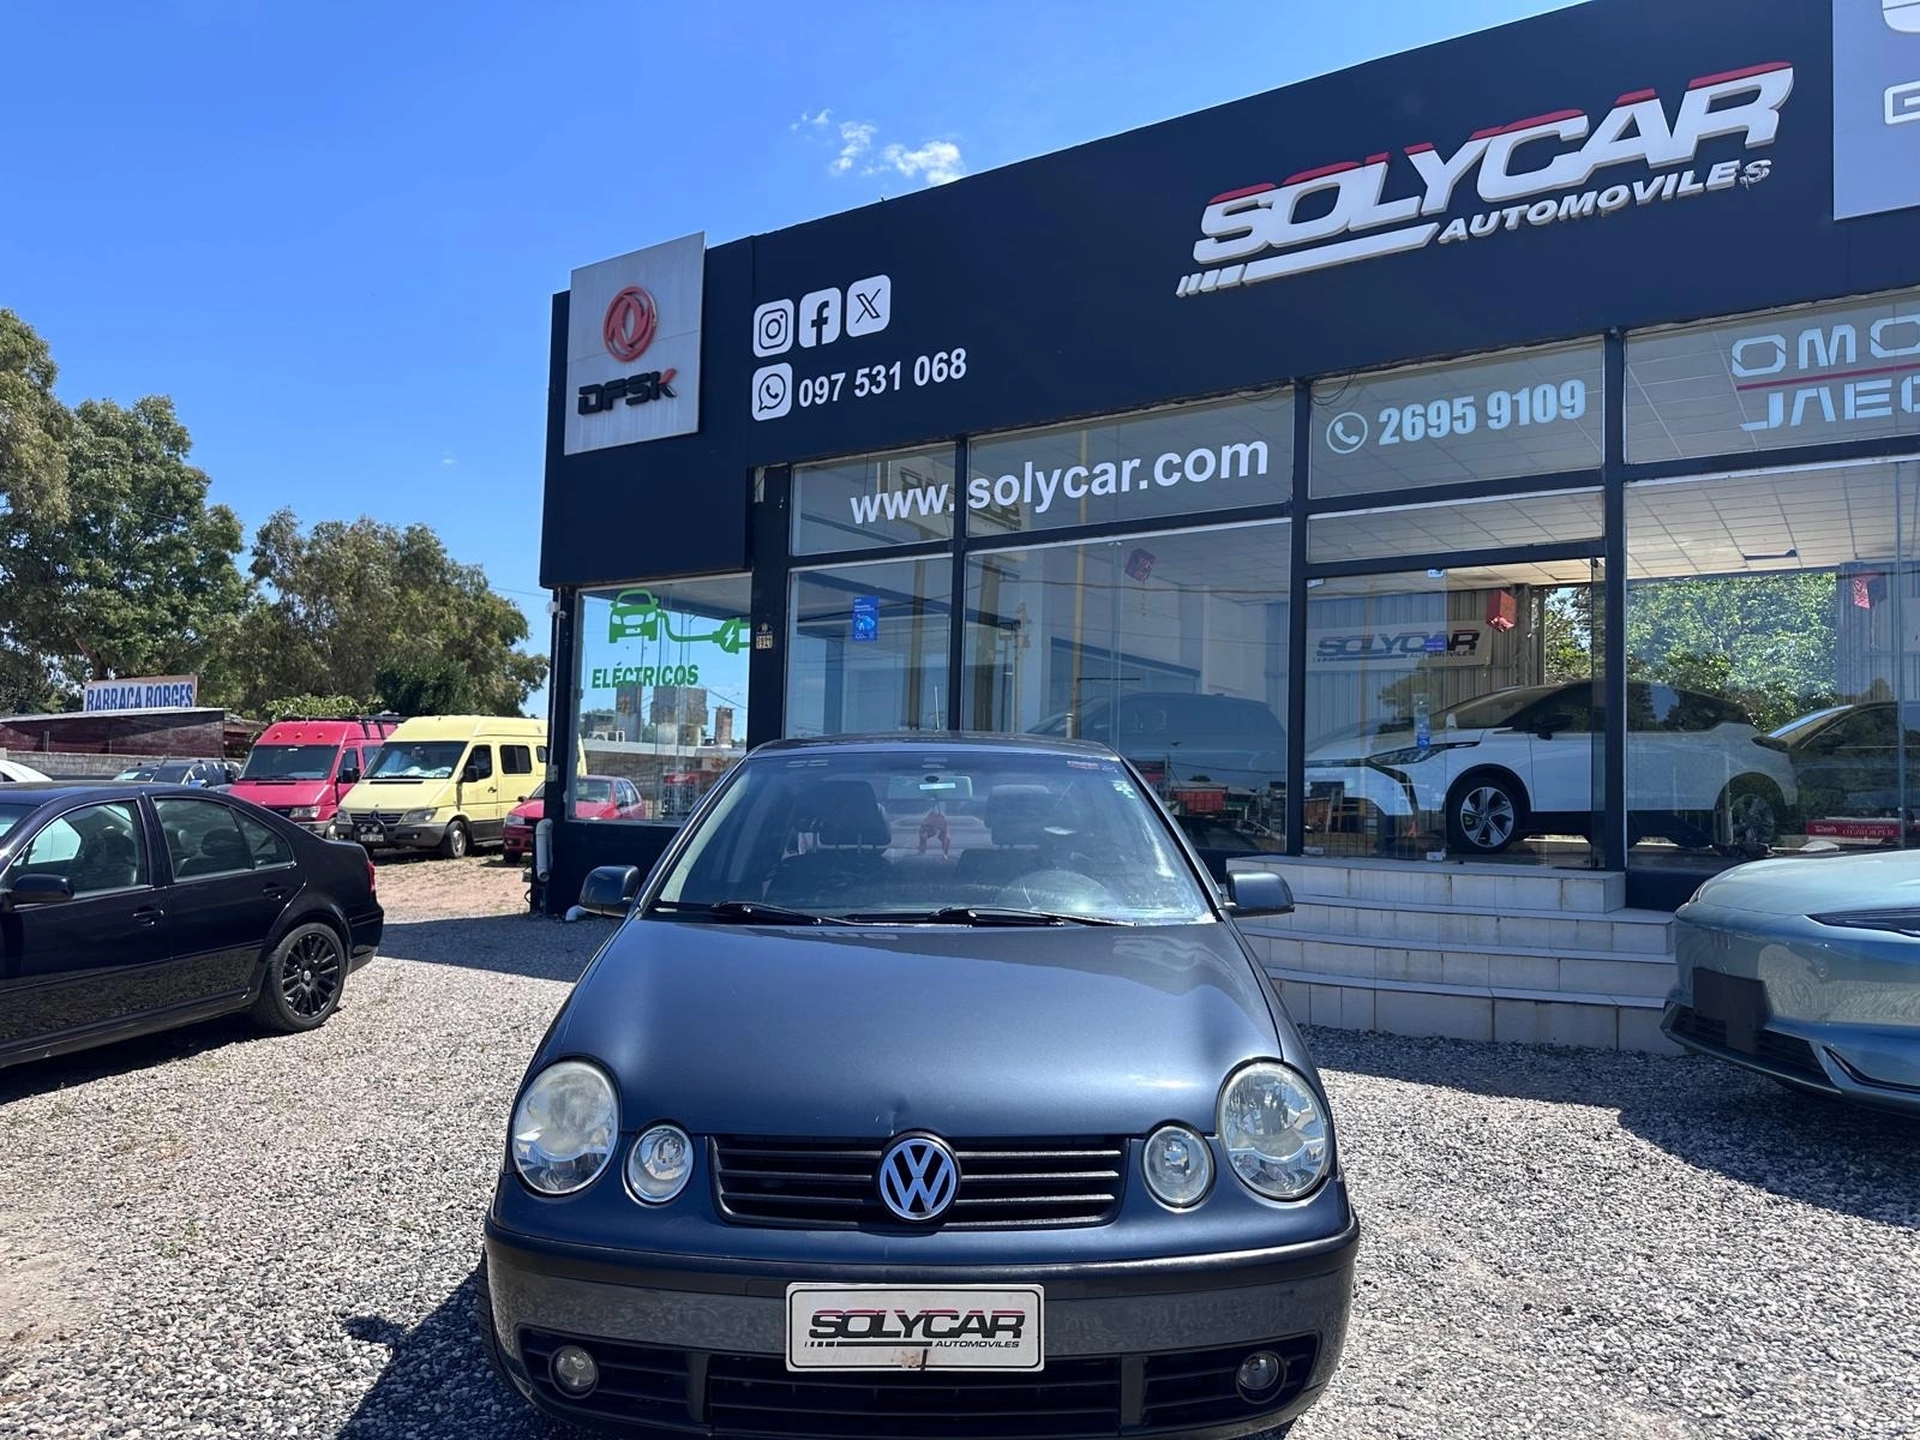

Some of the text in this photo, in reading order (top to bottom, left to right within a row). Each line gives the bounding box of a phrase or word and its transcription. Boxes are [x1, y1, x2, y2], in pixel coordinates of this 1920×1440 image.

[1192, 61, 1794, 264] SOLYCAR
[1438, 158, 1772, 243] AUTOMOVILES
[577, 368, 677, 416] DFSK
[799, 347, 967, 407] 097 531 068
[1378, 379, 1586, 445] 2695 9109
[592, 662, 699, 689] ELÉCTRICOS
[808, 1309, 1026, 1339] SOLYCAR
[935, 1340, 1020, 1349] AUTOMOVILES
